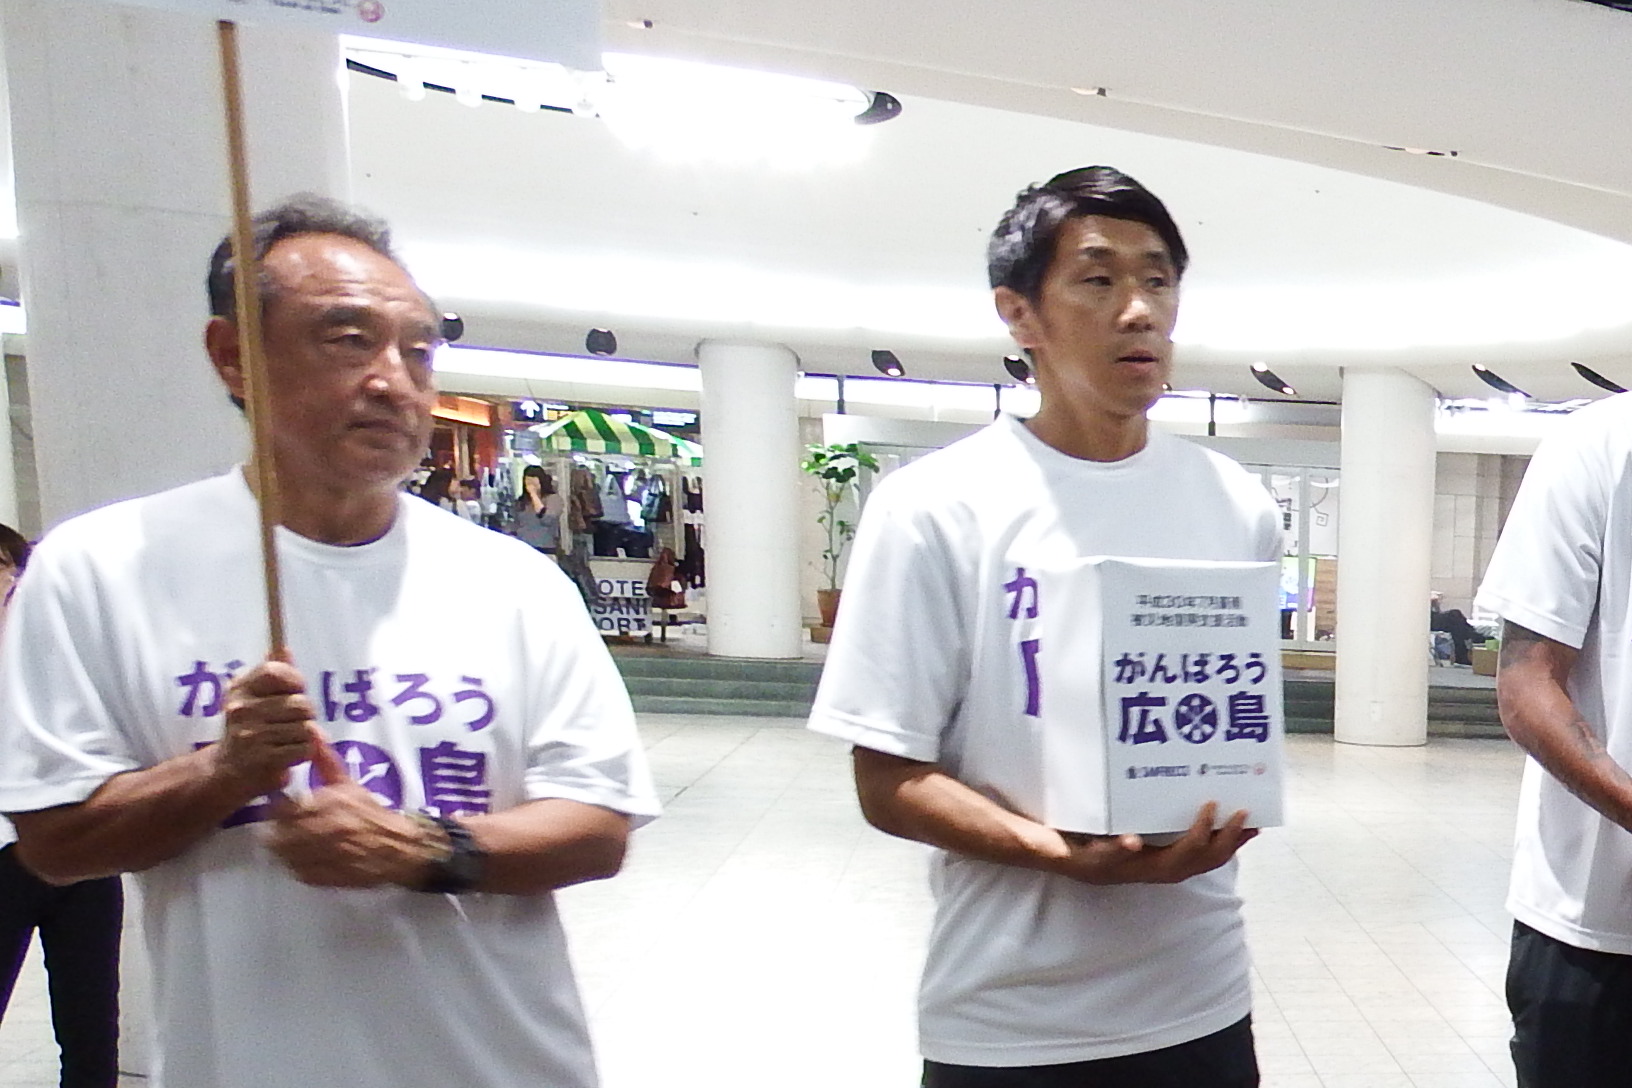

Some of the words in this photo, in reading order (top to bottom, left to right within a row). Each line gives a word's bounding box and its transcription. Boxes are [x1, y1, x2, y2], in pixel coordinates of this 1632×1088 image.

[1113, 652, 1268, 684] がんばろう
[176, 659, 496, 732] がばろう
